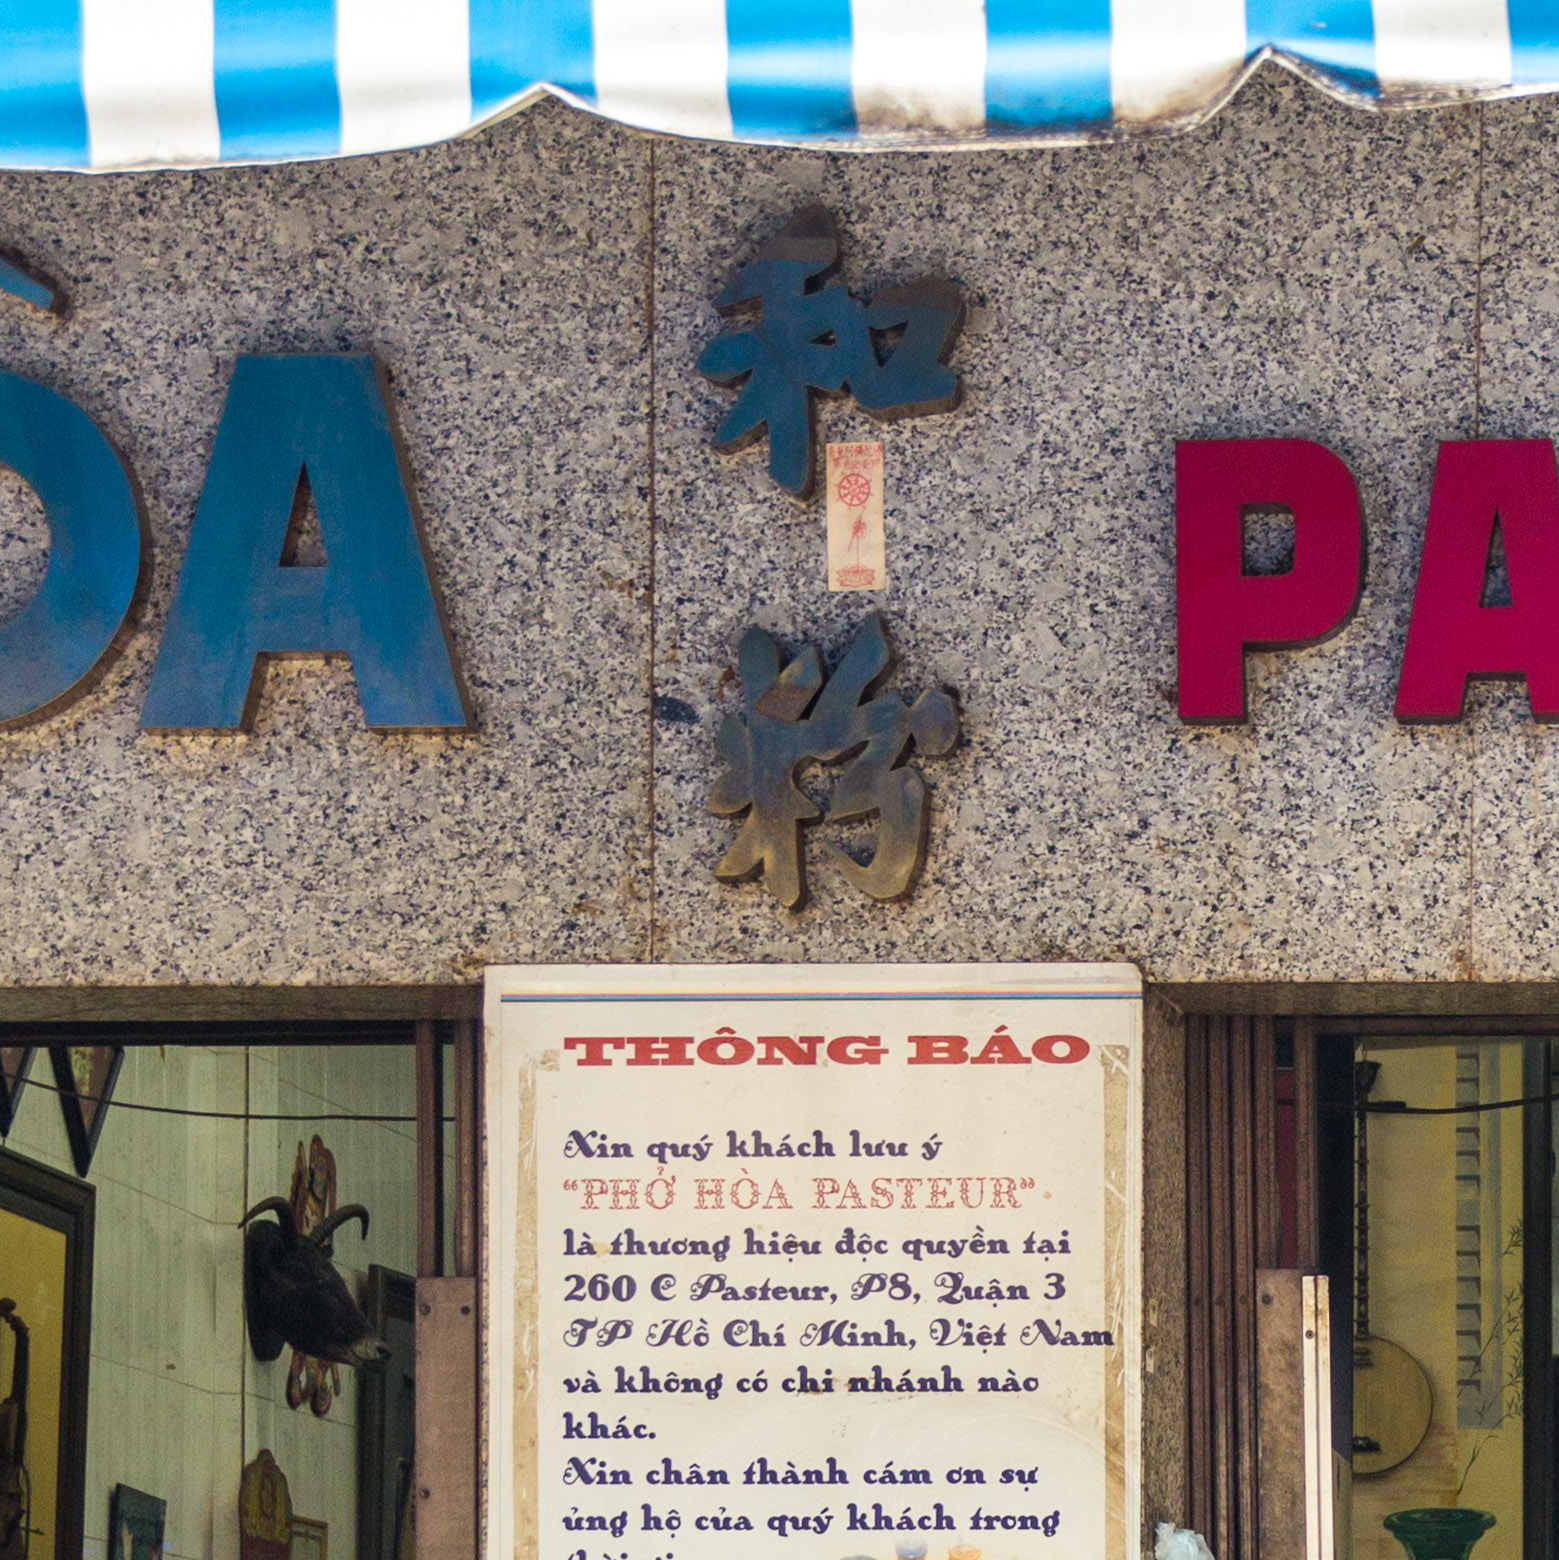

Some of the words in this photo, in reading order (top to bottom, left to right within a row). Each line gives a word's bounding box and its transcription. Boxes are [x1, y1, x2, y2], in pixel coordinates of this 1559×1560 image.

[564, 1027, 889, 1066] THÔNG
[907, 1025, 1090, 1065] BÁO
[564, 1130, 634, 1158] Xin
[647, 1134, 714, 1164] quý
[726, 1130, 835, 1157] khách
[849, 1129, 908, 1157] lưu
[922, 1133, 943, 1161] ý
[563, 1166, 676, 1210] “PHỞ
[694, 1168, 794, 1210] HÒA
[812, 1177, 1035, 1209] PASTEUR”
[563, 1228, 596, 1255] là
[609, 1228, 731, 1262] thương
[744, 1228, 821, 1262] hiệu
[835, 1227, 888, 1262] độc
[902, 1233, 1010, 1261] quyền
[1023, 1230, 1071, 1261] tại
[564, 1273, 636, 1302] 260
[651, 1273, 676, 1301] C
[690, 1274, 837, 1304] Pasteur,
[851, 1272, 921, 1304] P8,
[934, 1272, 1030, 1308] Quận
[1044, 1272, 1066, 1300] 3
[563, 1318, 633, 1347] TP
[646, 1318, 709, 1347] Hồ
[723, 1319, 786, 1347] Chí
[800, 1319, 916, 1350] Minh,
[930, 1318, 1007, 1354] Việt
[1020, 1319, 1115, 1347] Nam
[563, 1370, 601, 1393] và
[615, 1366, 723, 1400] không
[736, 1370, 768, 1393] có
[782, 1365, 835, 1394] chi
[847, 1365, 964, 1392] nhánh
[978, 1369, 1039, 1392] nào
[563, 1412, 656, 1439] khác.
[562, 1457, 632, 1485] Xin
[646, 1457, 730, 1485] chân
[743, 1457, 849, 1485] thành
[863, 1461, 933, 1484] cám
[946, 1467, 986, 1484] ơn
[999, 1467, 1038, 1492] sự
[562, 1507, 628, 1538] ủng
[640, 1503, 681, 1538] hộ
[695, 1507, 754, 1531] của
[767, 1507, 834, 1537] quý
[847, 1503, 956, 1530] khách
[970, 1507, 1060, 1537] trong
